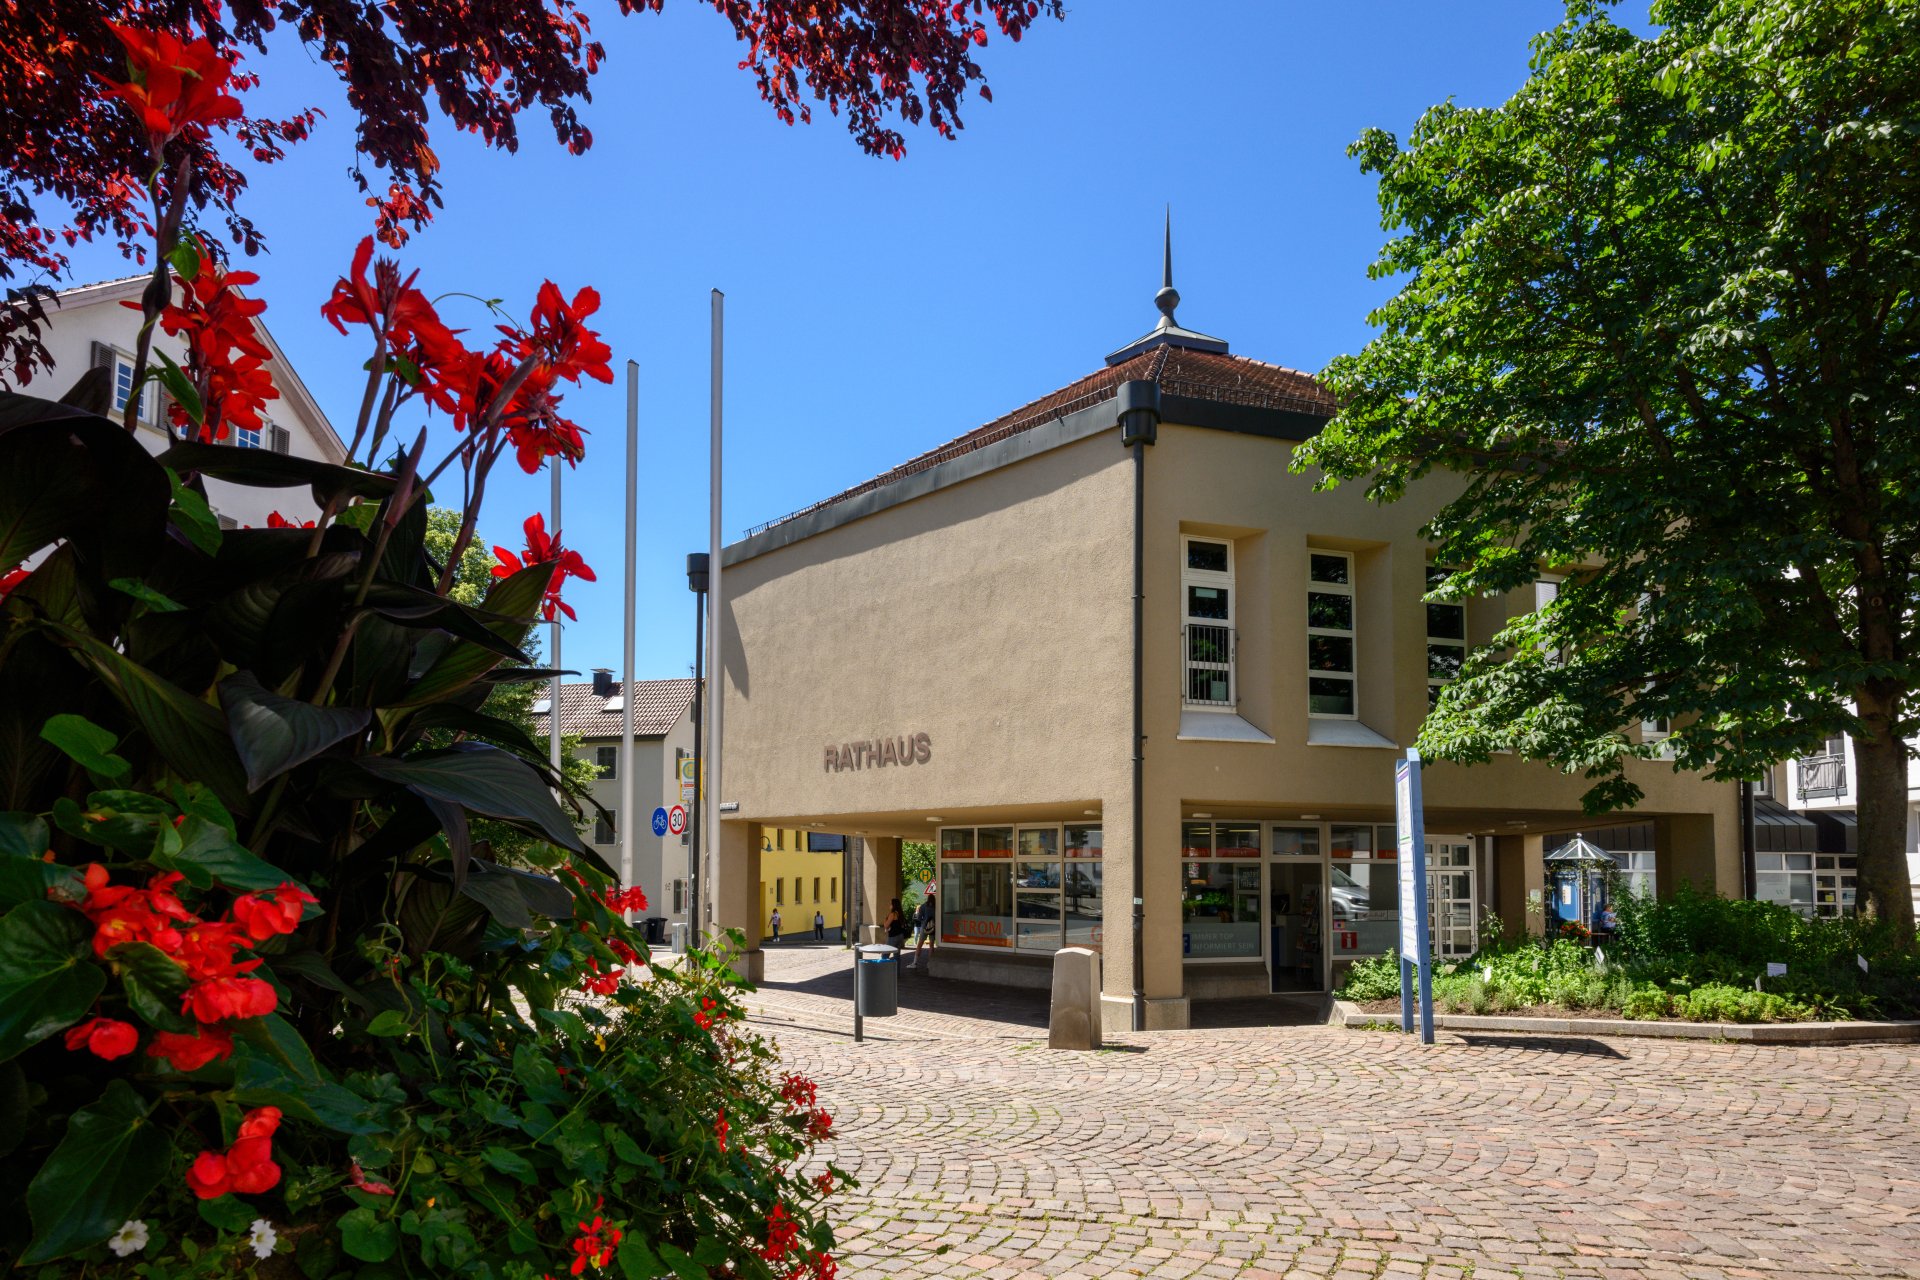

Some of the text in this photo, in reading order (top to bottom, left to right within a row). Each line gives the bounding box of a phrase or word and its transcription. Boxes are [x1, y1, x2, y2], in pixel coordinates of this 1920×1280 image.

[823, 732, 932, 773] RATHAUS
[672, 814, 682, 827] 30
[922, 870, 929, 881] H
[953, 918, 1002, 936] STROM
